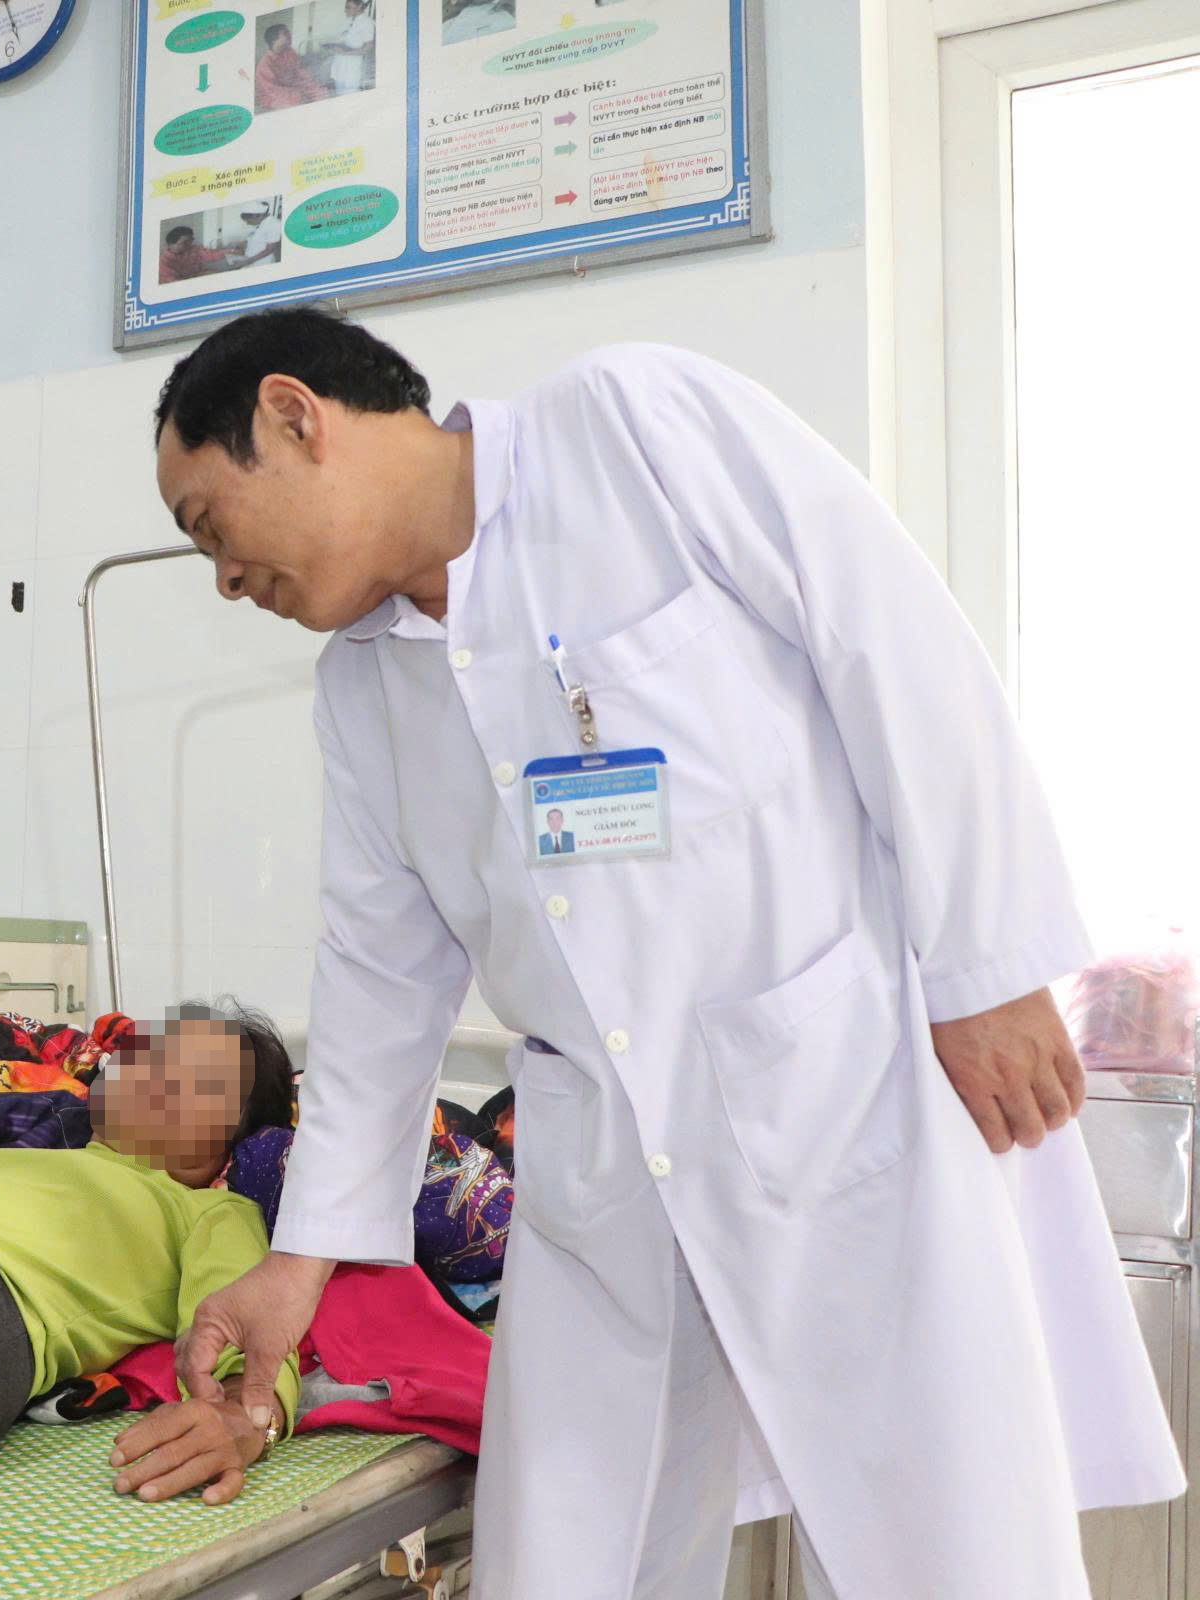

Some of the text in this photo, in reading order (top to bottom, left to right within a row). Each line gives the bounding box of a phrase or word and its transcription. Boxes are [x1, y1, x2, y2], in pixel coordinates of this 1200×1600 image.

[4, 40, 15, 58] 6
[600, 38, 626, 50] DVYT
[502, 51, 526, 63] NVYT
[668, 86, 685, 96] cho
[427, 79, 617, 128] 3. Các trường hợp đặc biệt:
[592, 111, 616, 122] NVYT
[617, 106, 640, 118] trong
[674, 117, 691, 129] định
[693, 114, 705, 123] NB
[505, 149, 526, 160] NVYT
[215, 170, 231, 182] Xác
[233, 166, 253, 179] định
[654, 163, 675, 174] NVYT
[705, 165, 724, 175] theo
[165, 175, 198, 190] Bước 2
[200, 176, 247, 193] 3 thông tin
[426, 187, 440, 197] cho
[614, 193, 629, 204] quy
[306, 200, 333, 212] NVYT
[575, 805, 609, 817] NGUYỄN
[631, 800, 655, 811] LONG
[593, 819, 618, 831] GIÁM
